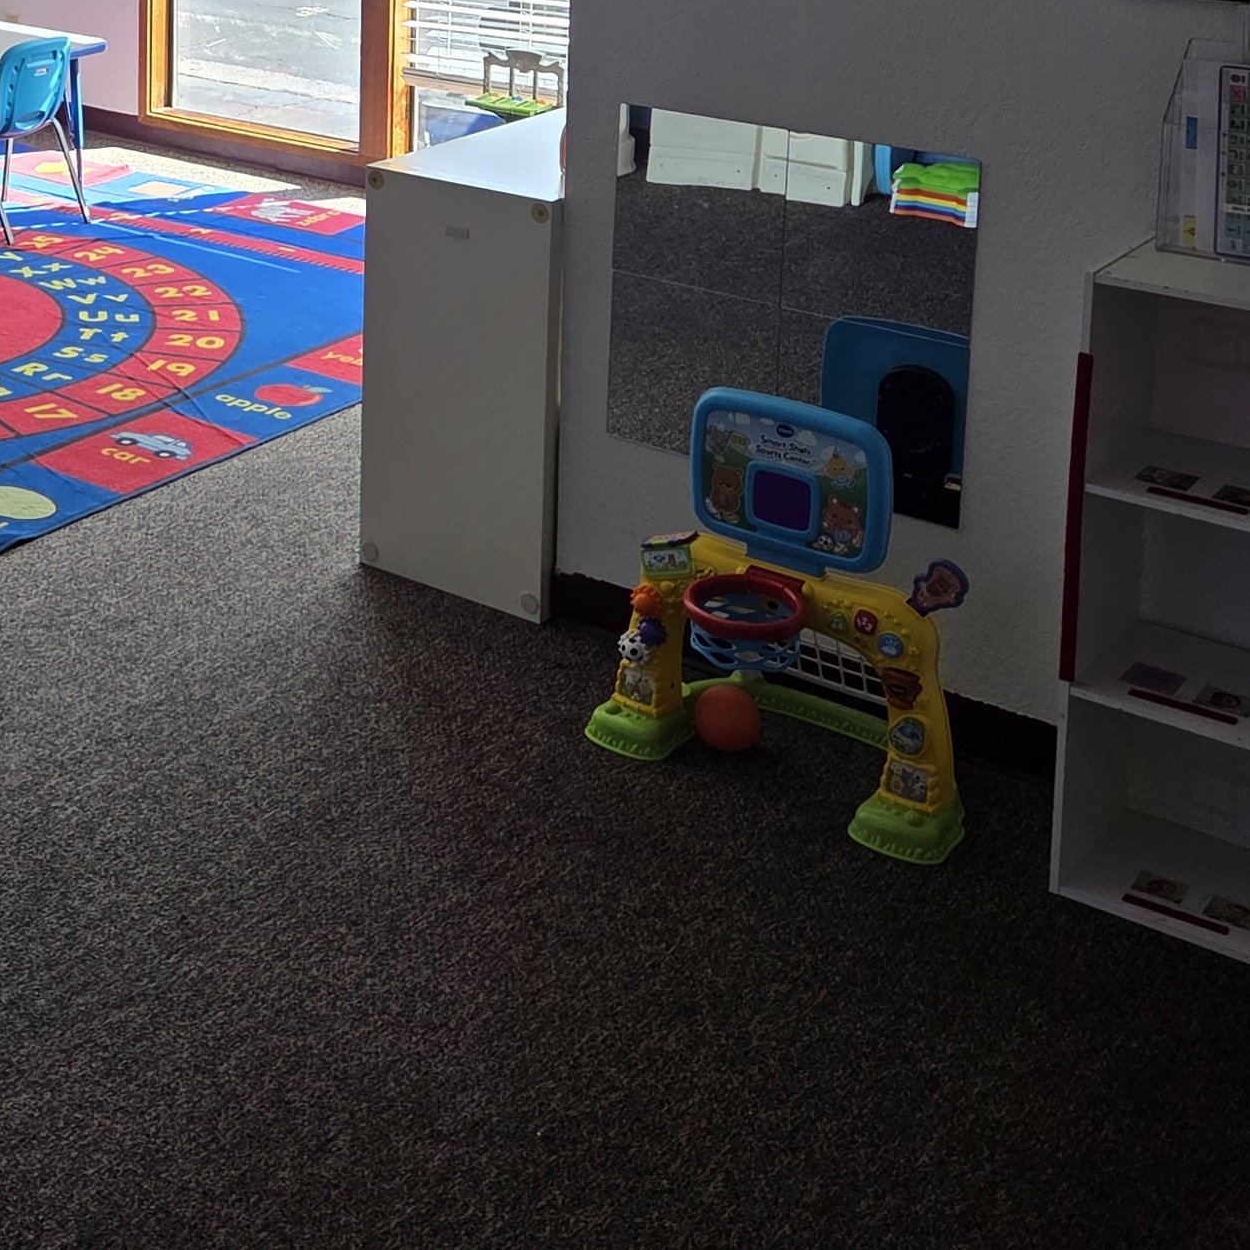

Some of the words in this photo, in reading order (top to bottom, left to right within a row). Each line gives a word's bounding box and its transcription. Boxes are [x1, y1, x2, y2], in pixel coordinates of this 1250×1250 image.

[18, 235, 64, 248] 25
[73, 246, 125, 262] 24
[121, 264, 175, 278] 23
[153, 285, 213, 298] 22
[171, 309, 220, 322] 21
[164, 333, 225, 349] 20
[147, 359, 197, 377] 19
[95, 383, 148, 401] 18
[23, 403, 79, 419] 17
[215, 393, 293, 420] apple
[756, 444, 782, 459] Sports
[761, 434, 786, 448] Smart
[789, 443, 811, 456] Shots
[100, 447, 151, 465] car
